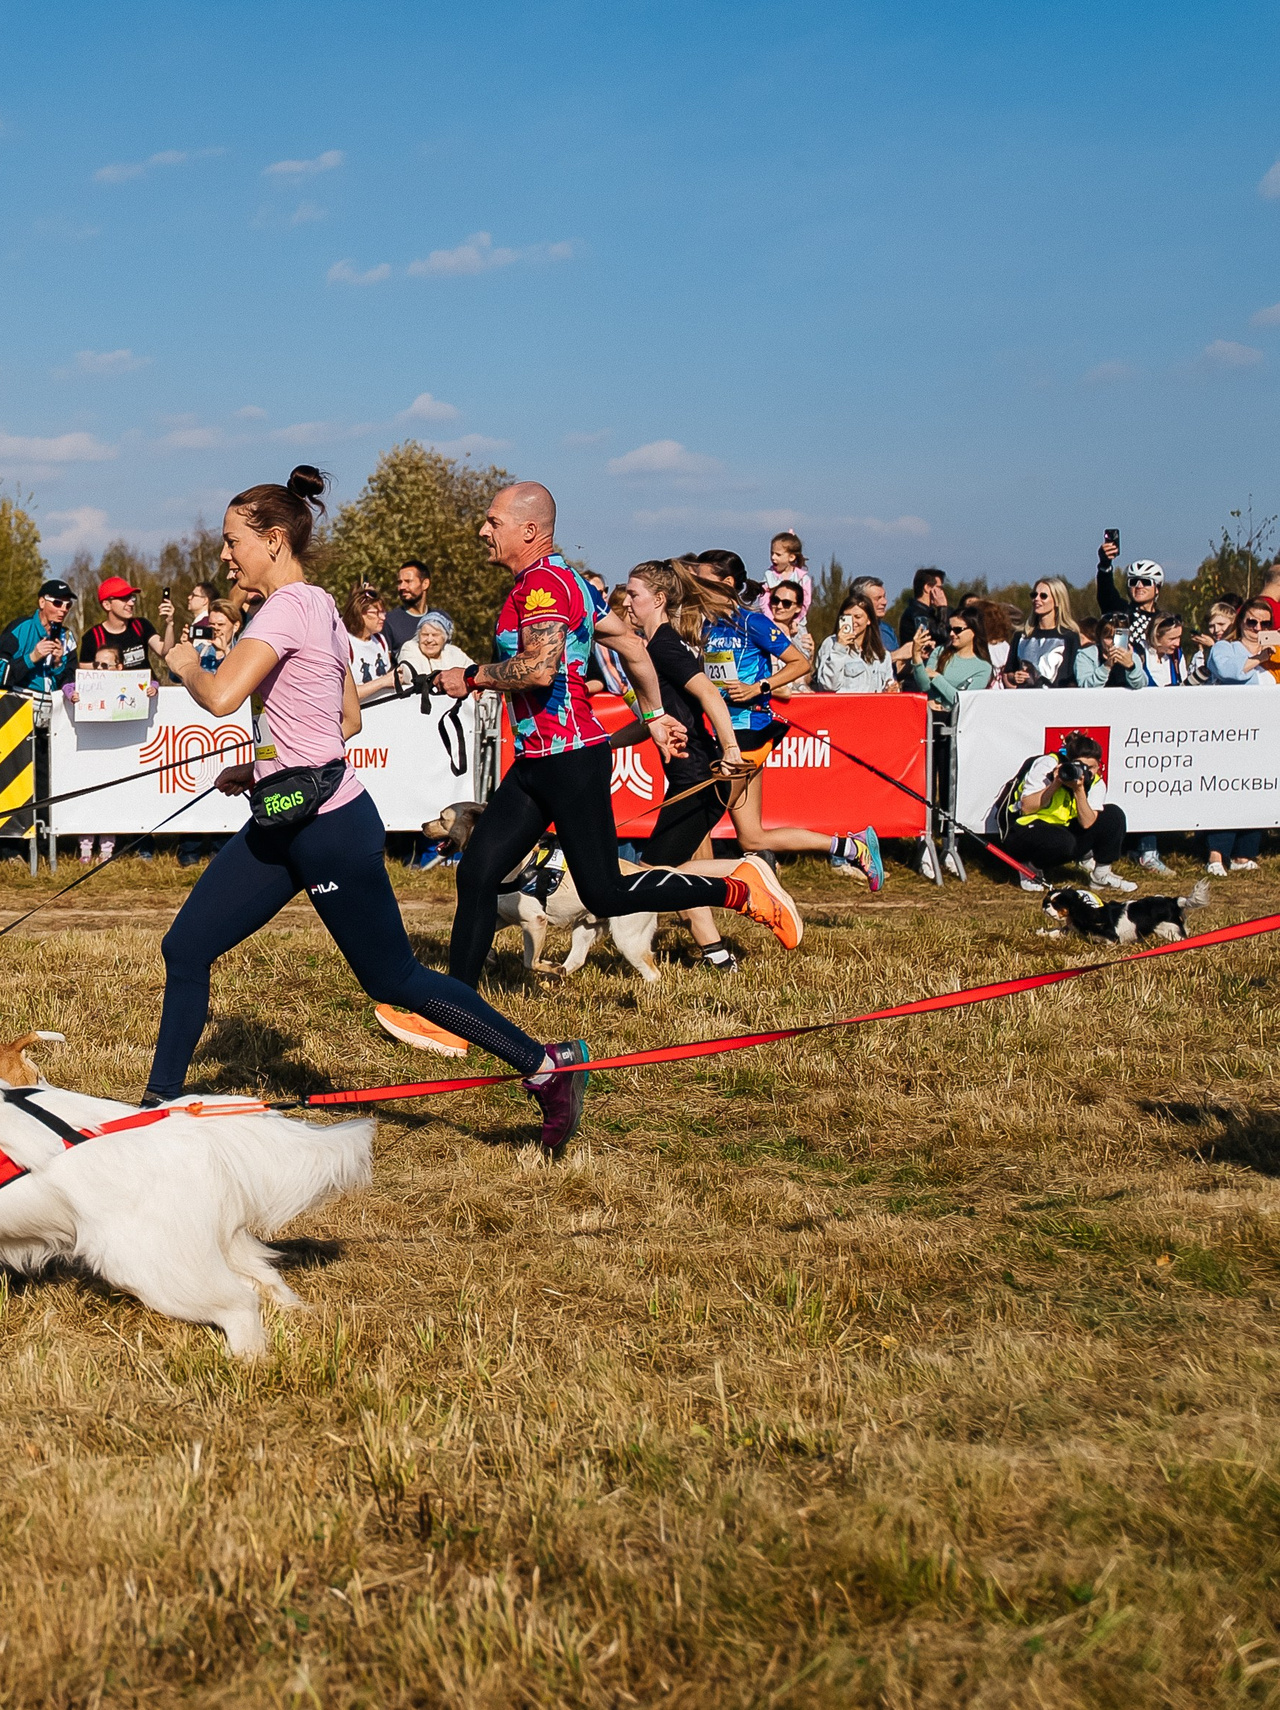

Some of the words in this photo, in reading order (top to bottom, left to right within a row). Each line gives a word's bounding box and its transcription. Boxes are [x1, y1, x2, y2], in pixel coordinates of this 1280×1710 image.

[708, 665, 727, 679] 231
[1124, 727, 1260, 748] Департамент
[1124, 754, 1193, 773] спорта
[1124, 779, 1193, 798] города
[1199, 775, 1278, 792] Москвы
[311, 881, 339, 895] FILA
